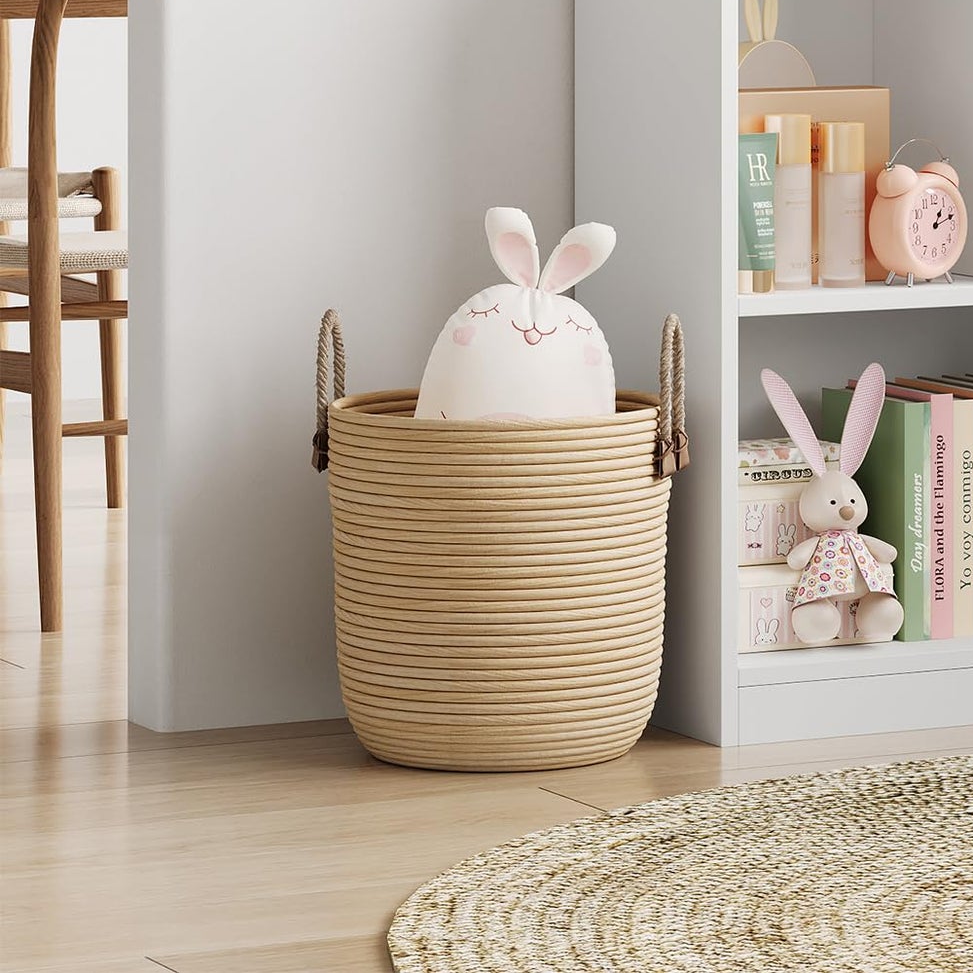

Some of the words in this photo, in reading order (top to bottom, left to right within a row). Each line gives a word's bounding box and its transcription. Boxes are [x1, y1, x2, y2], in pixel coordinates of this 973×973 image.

[922, 199, 928, 209] 11
[930, 194, 938, 205] 12
[942, 197, 945, 208] 1
[915, 208, 923, 220] 10
[913, 222, 918, 234] 9
[950, 220, 955, 231] 3
[915, 234, 921, 246] 8
[946, 233, 952, 243] 4
[923, 245, 927, 255] 7
[931, 247, 937, 258] 6
[941, 243, 946, 254] 5
[934, 435, 946, 499] Flamingo
[961, 450, 973, 524] conmigo
[908, 473, 923, 538] dreamers
[934, 502, 944, 524] the
[934, 529, 944, 554] and
[963, 531, 973, 561] voy
[911, 541, 927, 573] Day
[934, 558, 944, 600] FLORA
[960, 568, 971, 590] Yo
